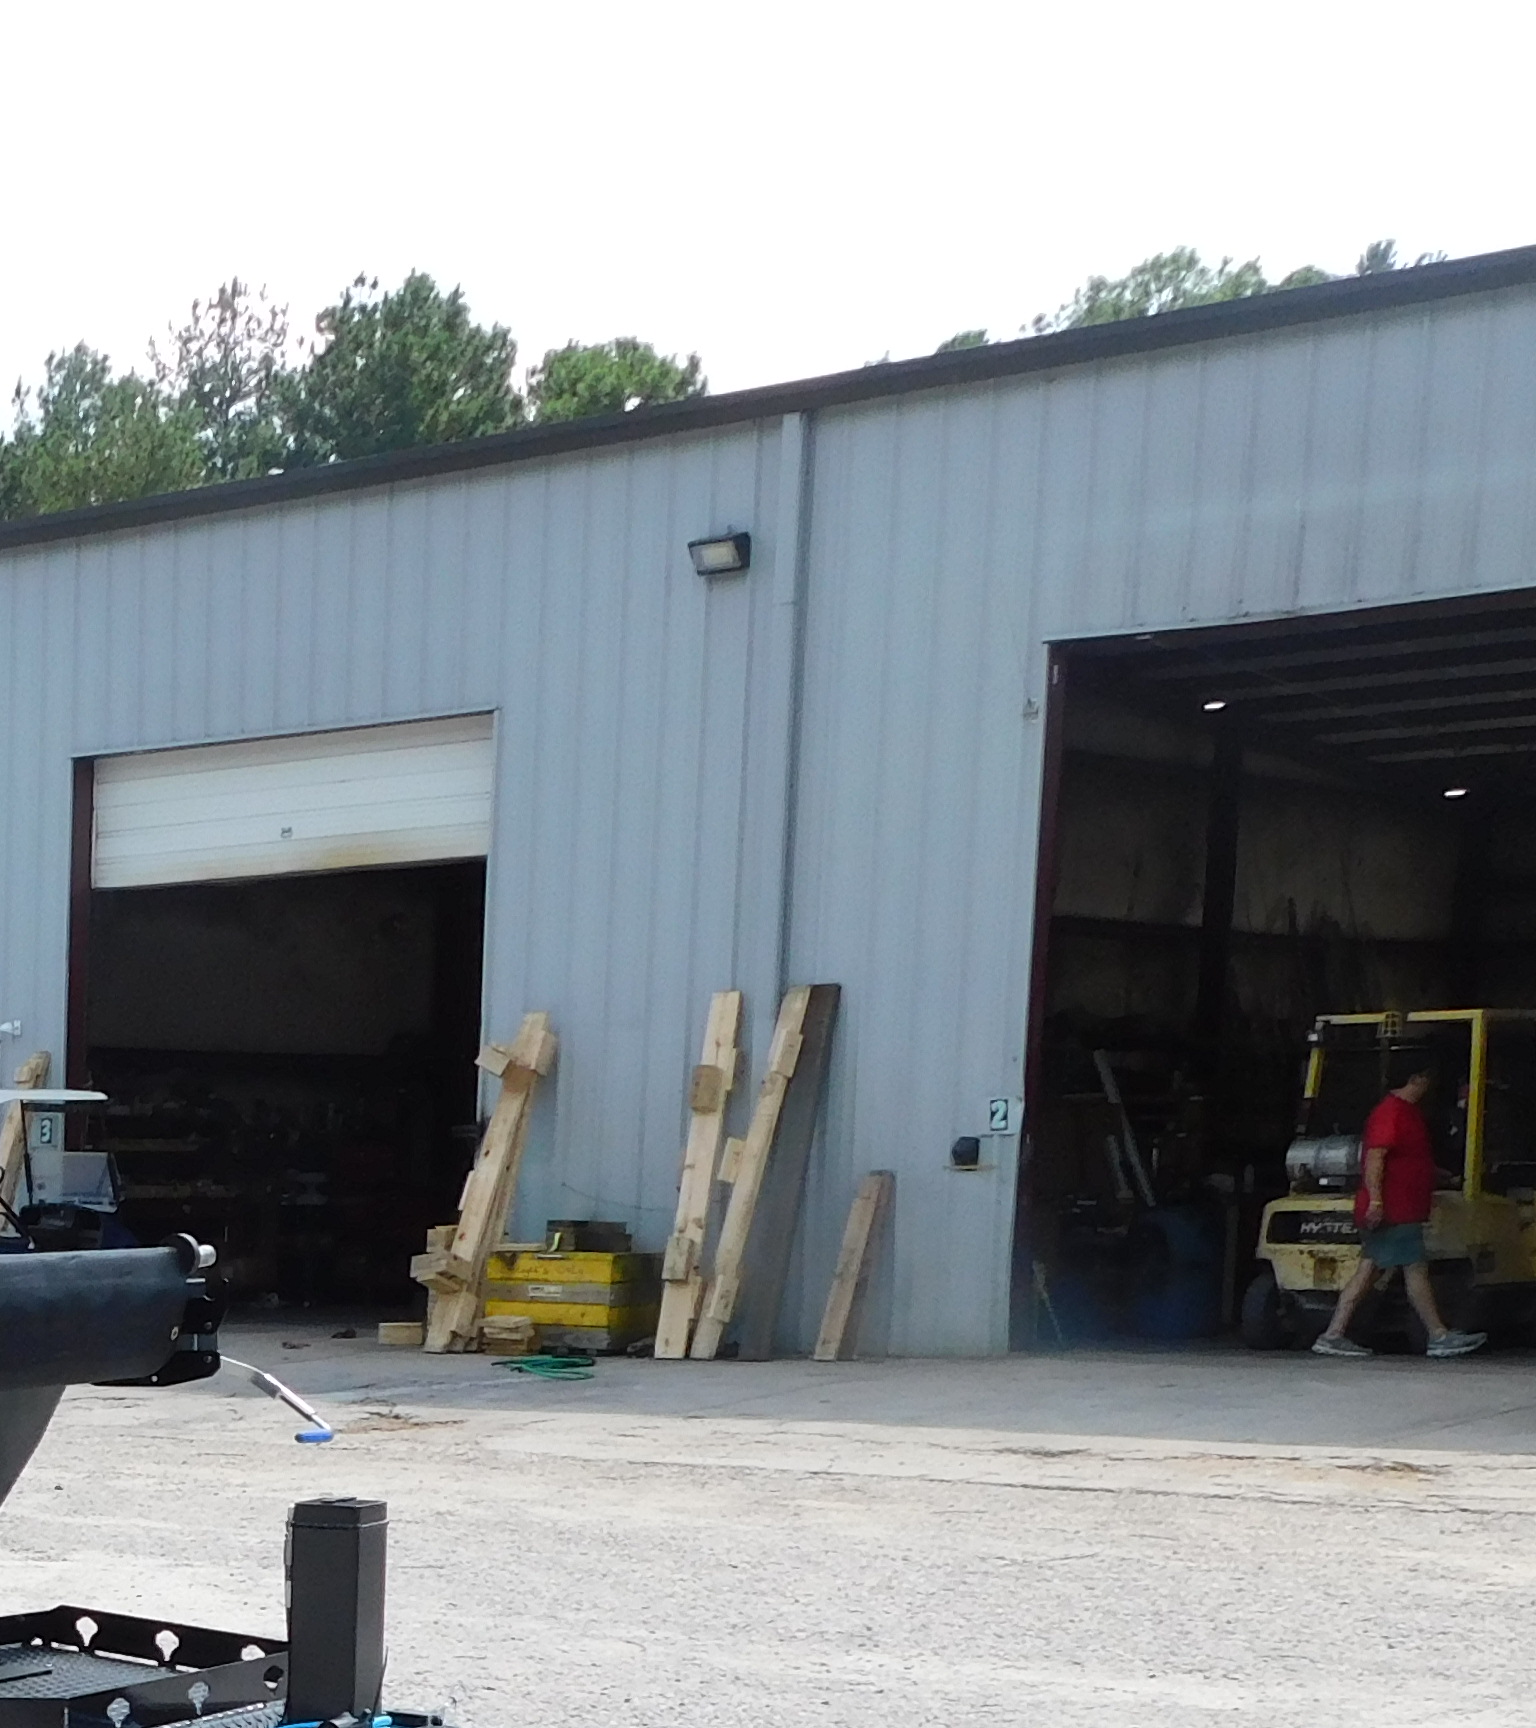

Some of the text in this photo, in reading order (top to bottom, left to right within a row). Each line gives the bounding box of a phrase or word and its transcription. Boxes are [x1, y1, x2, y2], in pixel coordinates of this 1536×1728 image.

[991, 1100, 1007, 1129] 2
[41, 1119, 52, 1142] 3
[1300, 1222, 1358, 1234] HYTE
